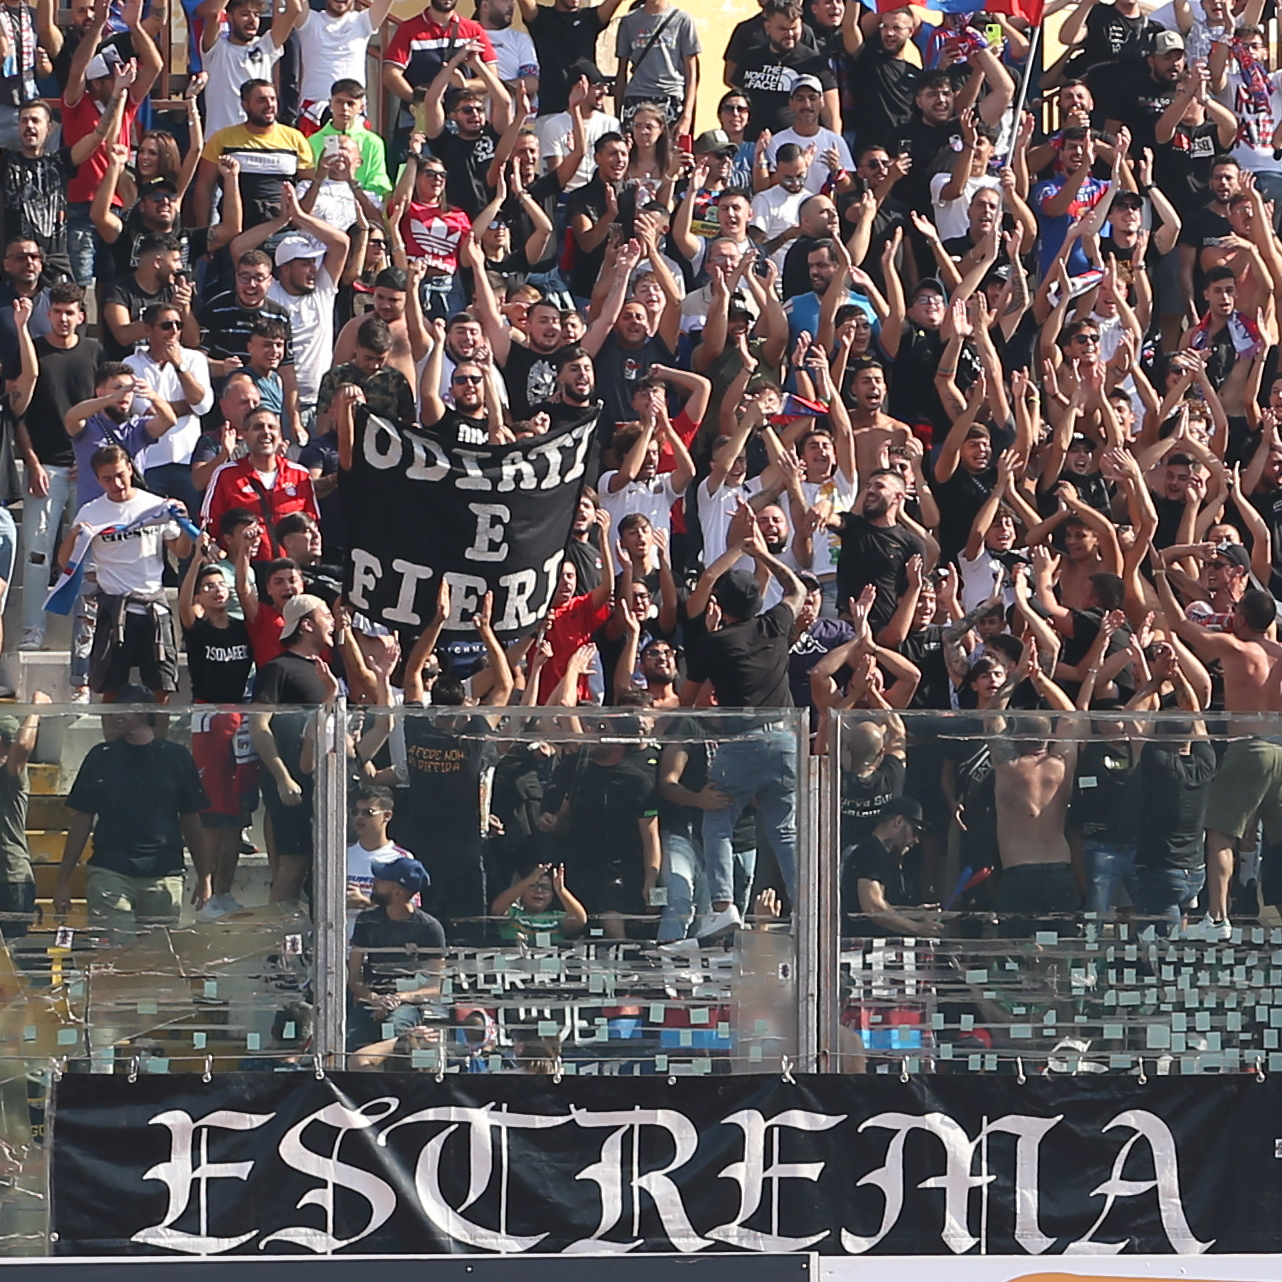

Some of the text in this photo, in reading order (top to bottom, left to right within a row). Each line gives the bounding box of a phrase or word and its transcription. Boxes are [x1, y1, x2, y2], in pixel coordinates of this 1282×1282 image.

[743, 70, 779, 82] NORTH
[747, 80, 776, 91] FACE
[762, 64, 780, 75] THE
[363, 415, 598, 492] ODIATI
[464, 502, 511, 562] E
[348, 548, 565, 633] FIERI
[130, 1095, 1214, 1255] ESTREMA
